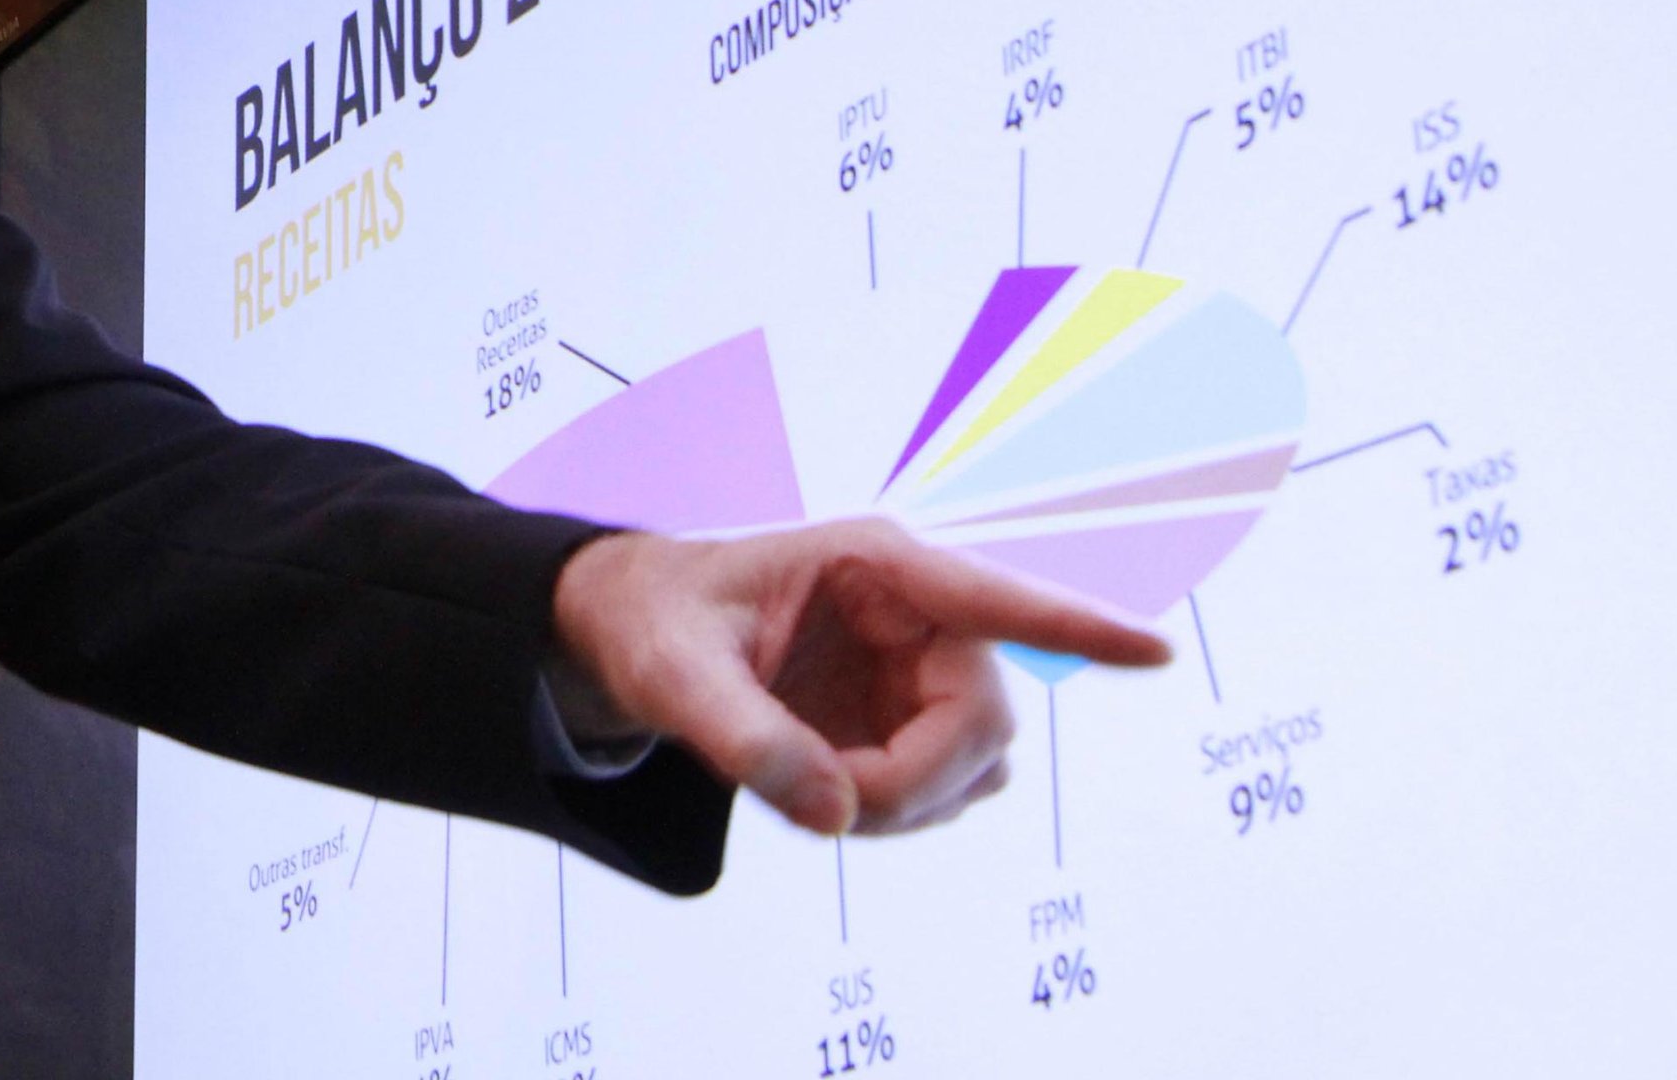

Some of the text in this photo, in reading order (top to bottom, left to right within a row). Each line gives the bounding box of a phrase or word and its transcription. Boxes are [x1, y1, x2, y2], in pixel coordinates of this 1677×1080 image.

[1001, 18, 1056, 76] IRRF
[1237, 27, 1288, 83] ITBI
[837, 88, 890, 142] IPTU
[1002, 67, 1065, 132] 4%
[1234, 74, 1306, 152] 5%
[1413, 100, 1462, 153] ISS
[838, 132, 894, 194] 6%
[1391, 141, 1500, 231] 14%
[233, 150, 406, 341] RECEITAS
[483, 289, 538, 337] Outras
[476, 318, 547, 374] Receitas
[485, 358, 541, 418] 18%
[1425, 450, 1518, 510] Taxas
[1436, 502, 1521, 575] 2%
[1200, 708, 1323, 775] Serviços
[1230, 766, 1304, 836] 9%
[248, 823, 349, 893] Outras transf.
[280, 879, 318, 932] 5%
[1029, 892, 1084, 946] FPM
[828, 967, 874, 1014] SUS
[1029, 948, 1097, 1010] 4%
[414, 1021, 454, 1062] IPVA
[544, 1021, 592, 1067] ICMS
[817, 1015, 896, 1079] 11%
